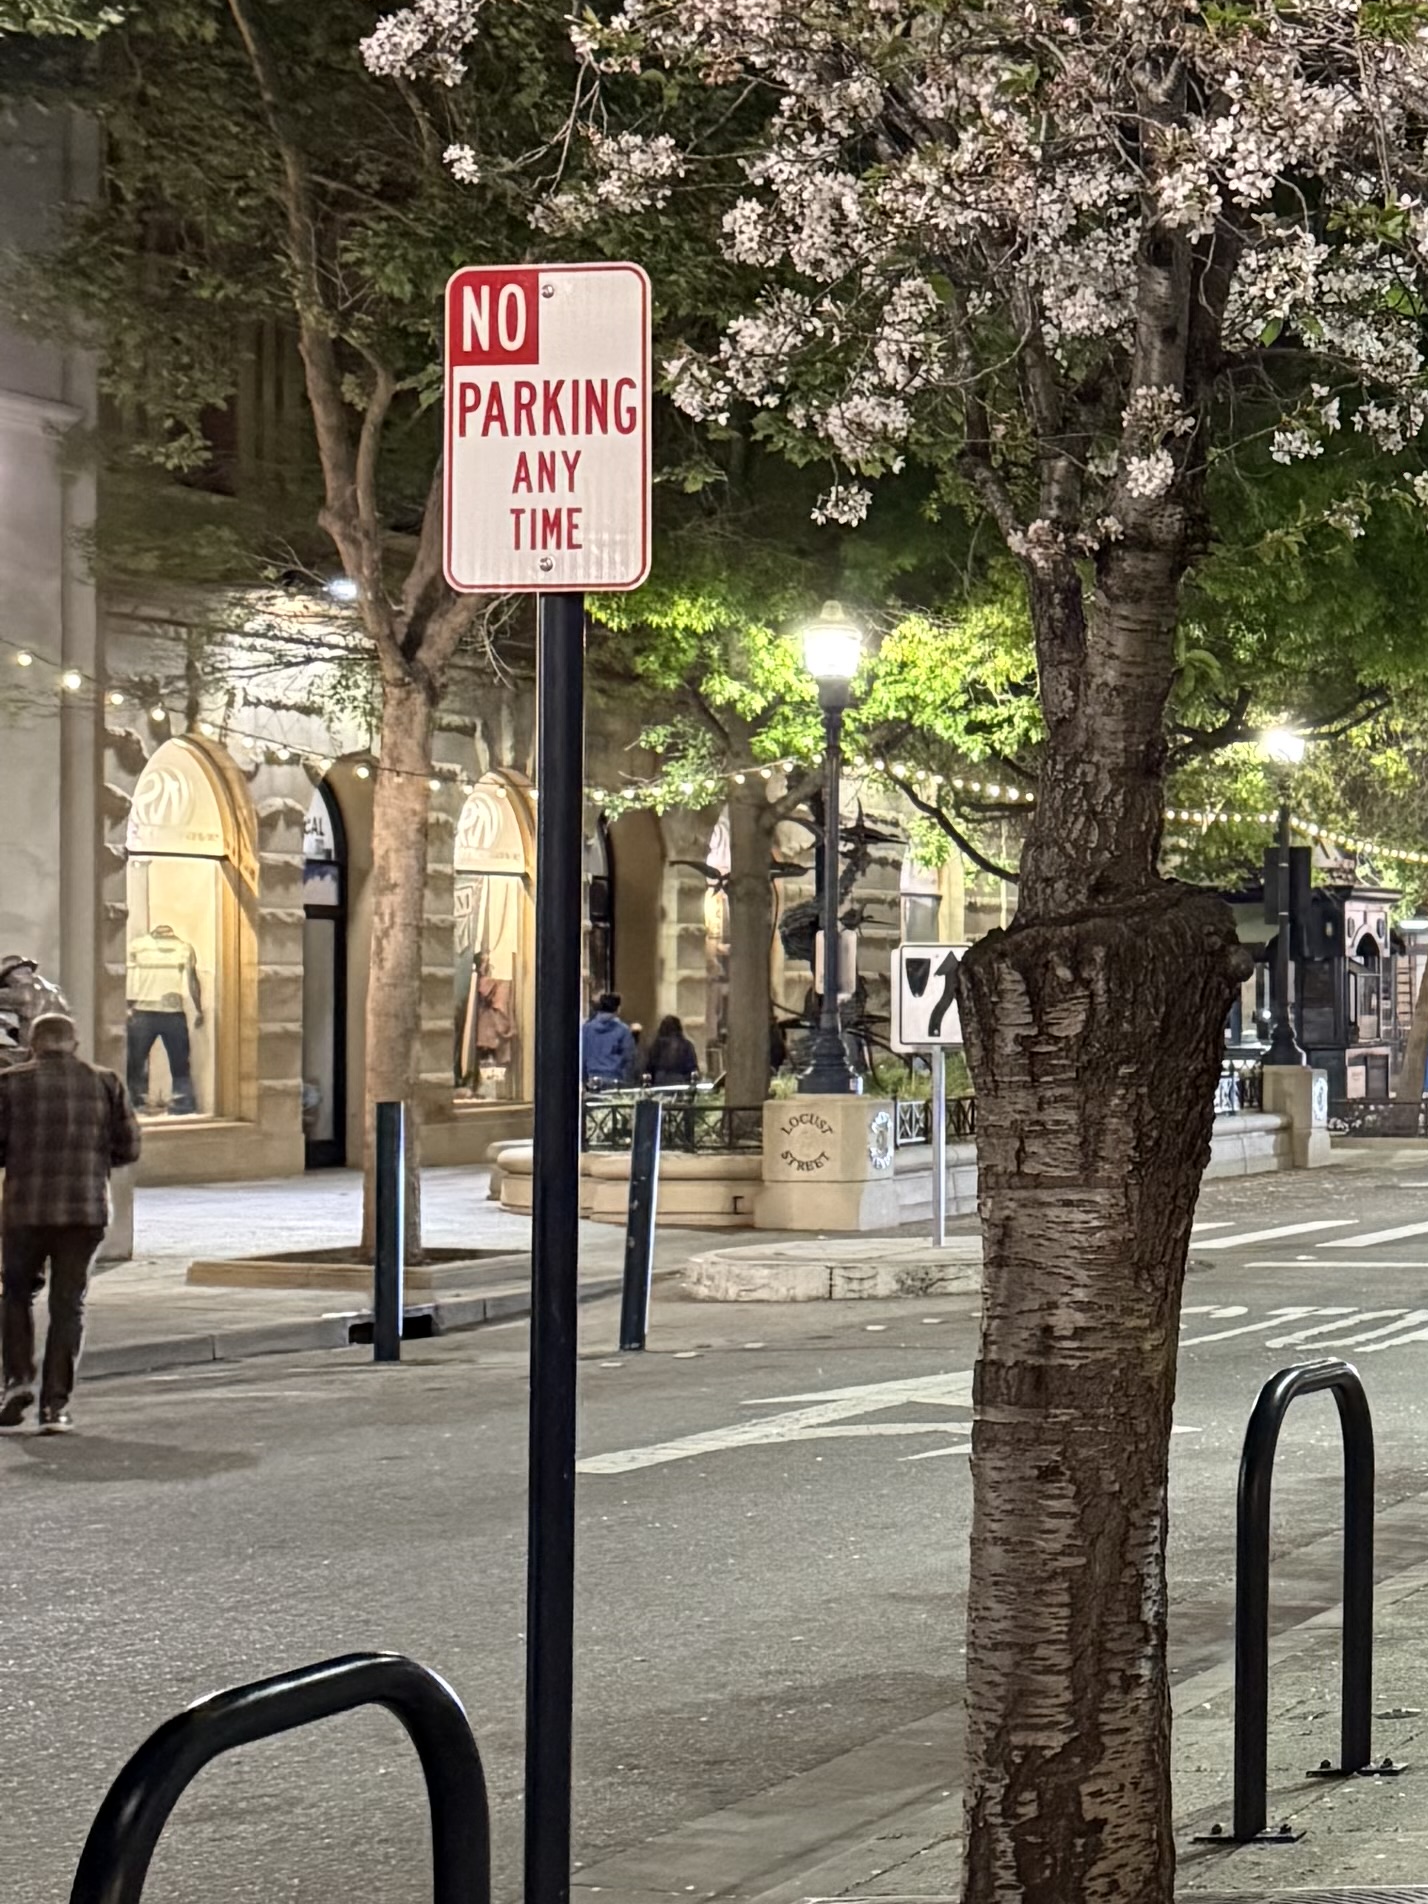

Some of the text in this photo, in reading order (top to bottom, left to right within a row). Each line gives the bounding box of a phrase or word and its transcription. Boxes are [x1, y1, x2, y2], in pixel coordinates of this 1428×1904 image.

[462, 283, 527, 353] NO
[458, 377, 637, 438] PARKING
[511, 450, 582, 494] ANY
[510, 507, 583, 551] TIME
[780, 1112, 834, 1136] LOCUST
[780, 1149, 830, 1172] STREET
